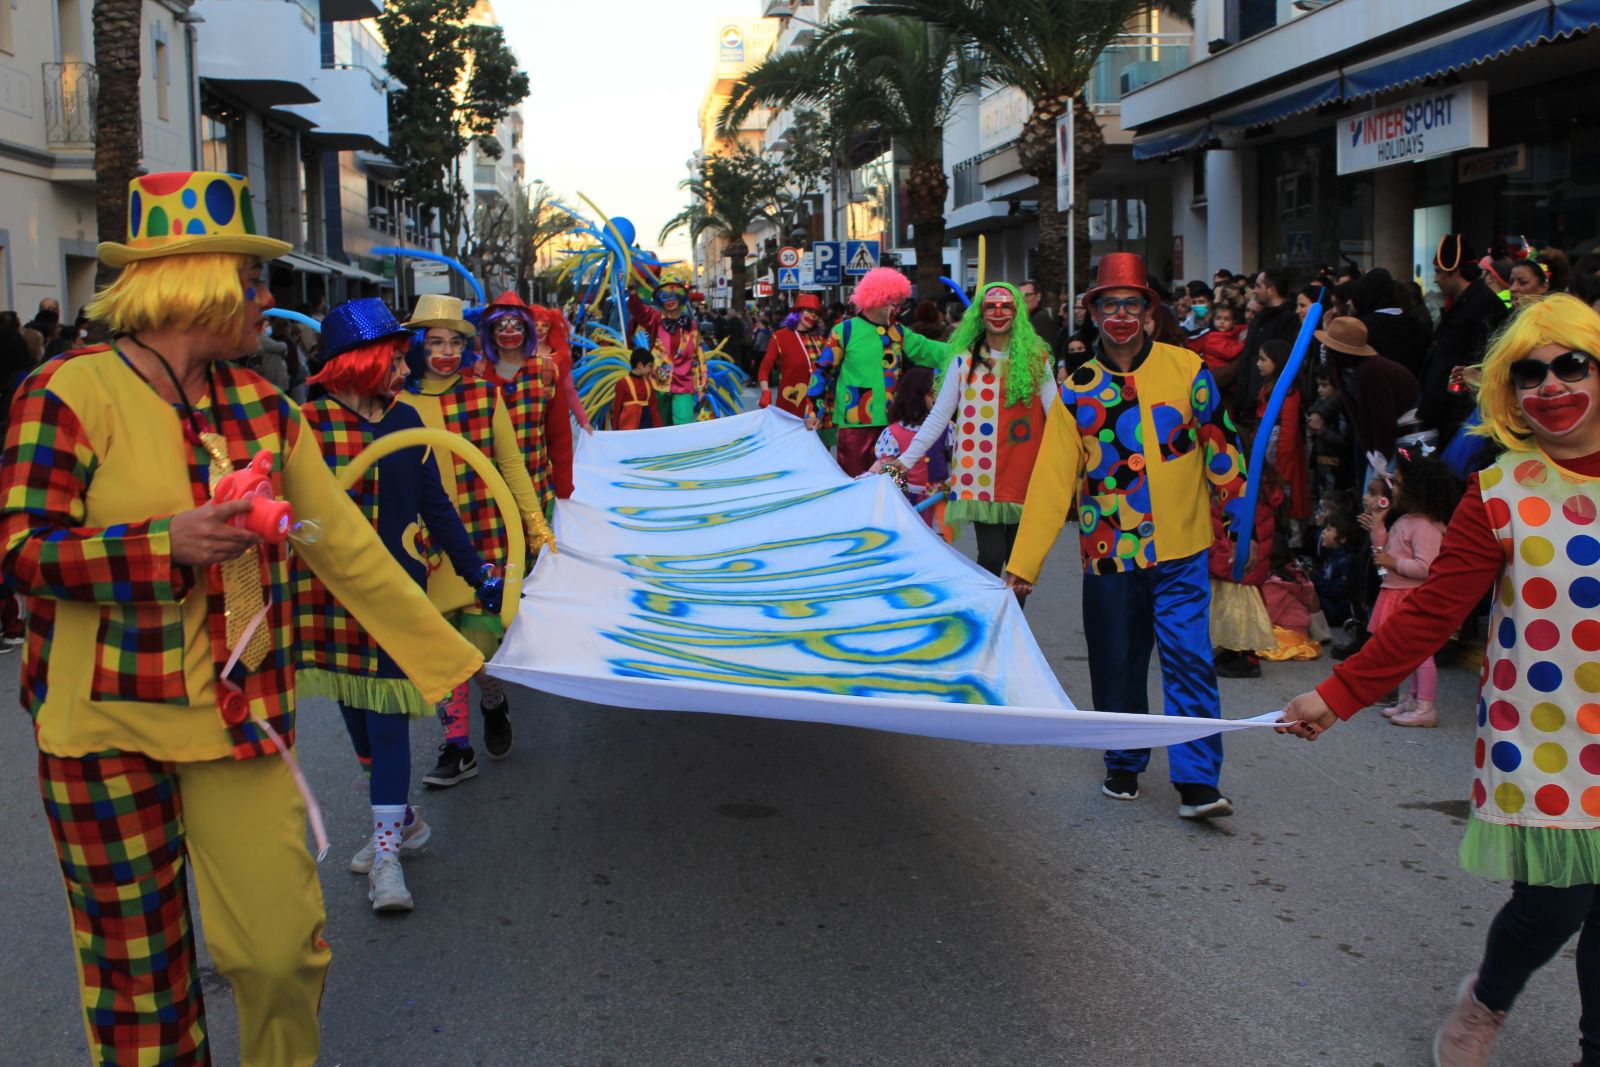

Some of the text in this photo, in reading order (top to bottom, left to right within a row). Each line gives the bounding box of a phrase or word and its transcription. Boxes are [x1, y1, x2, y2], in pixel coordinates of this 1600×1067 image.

[1363, 94, 1456, 145] INTERSPORT
[1378, 133, 1424, 162] HOLIDAYS
[815, 245, 834, 270] P
